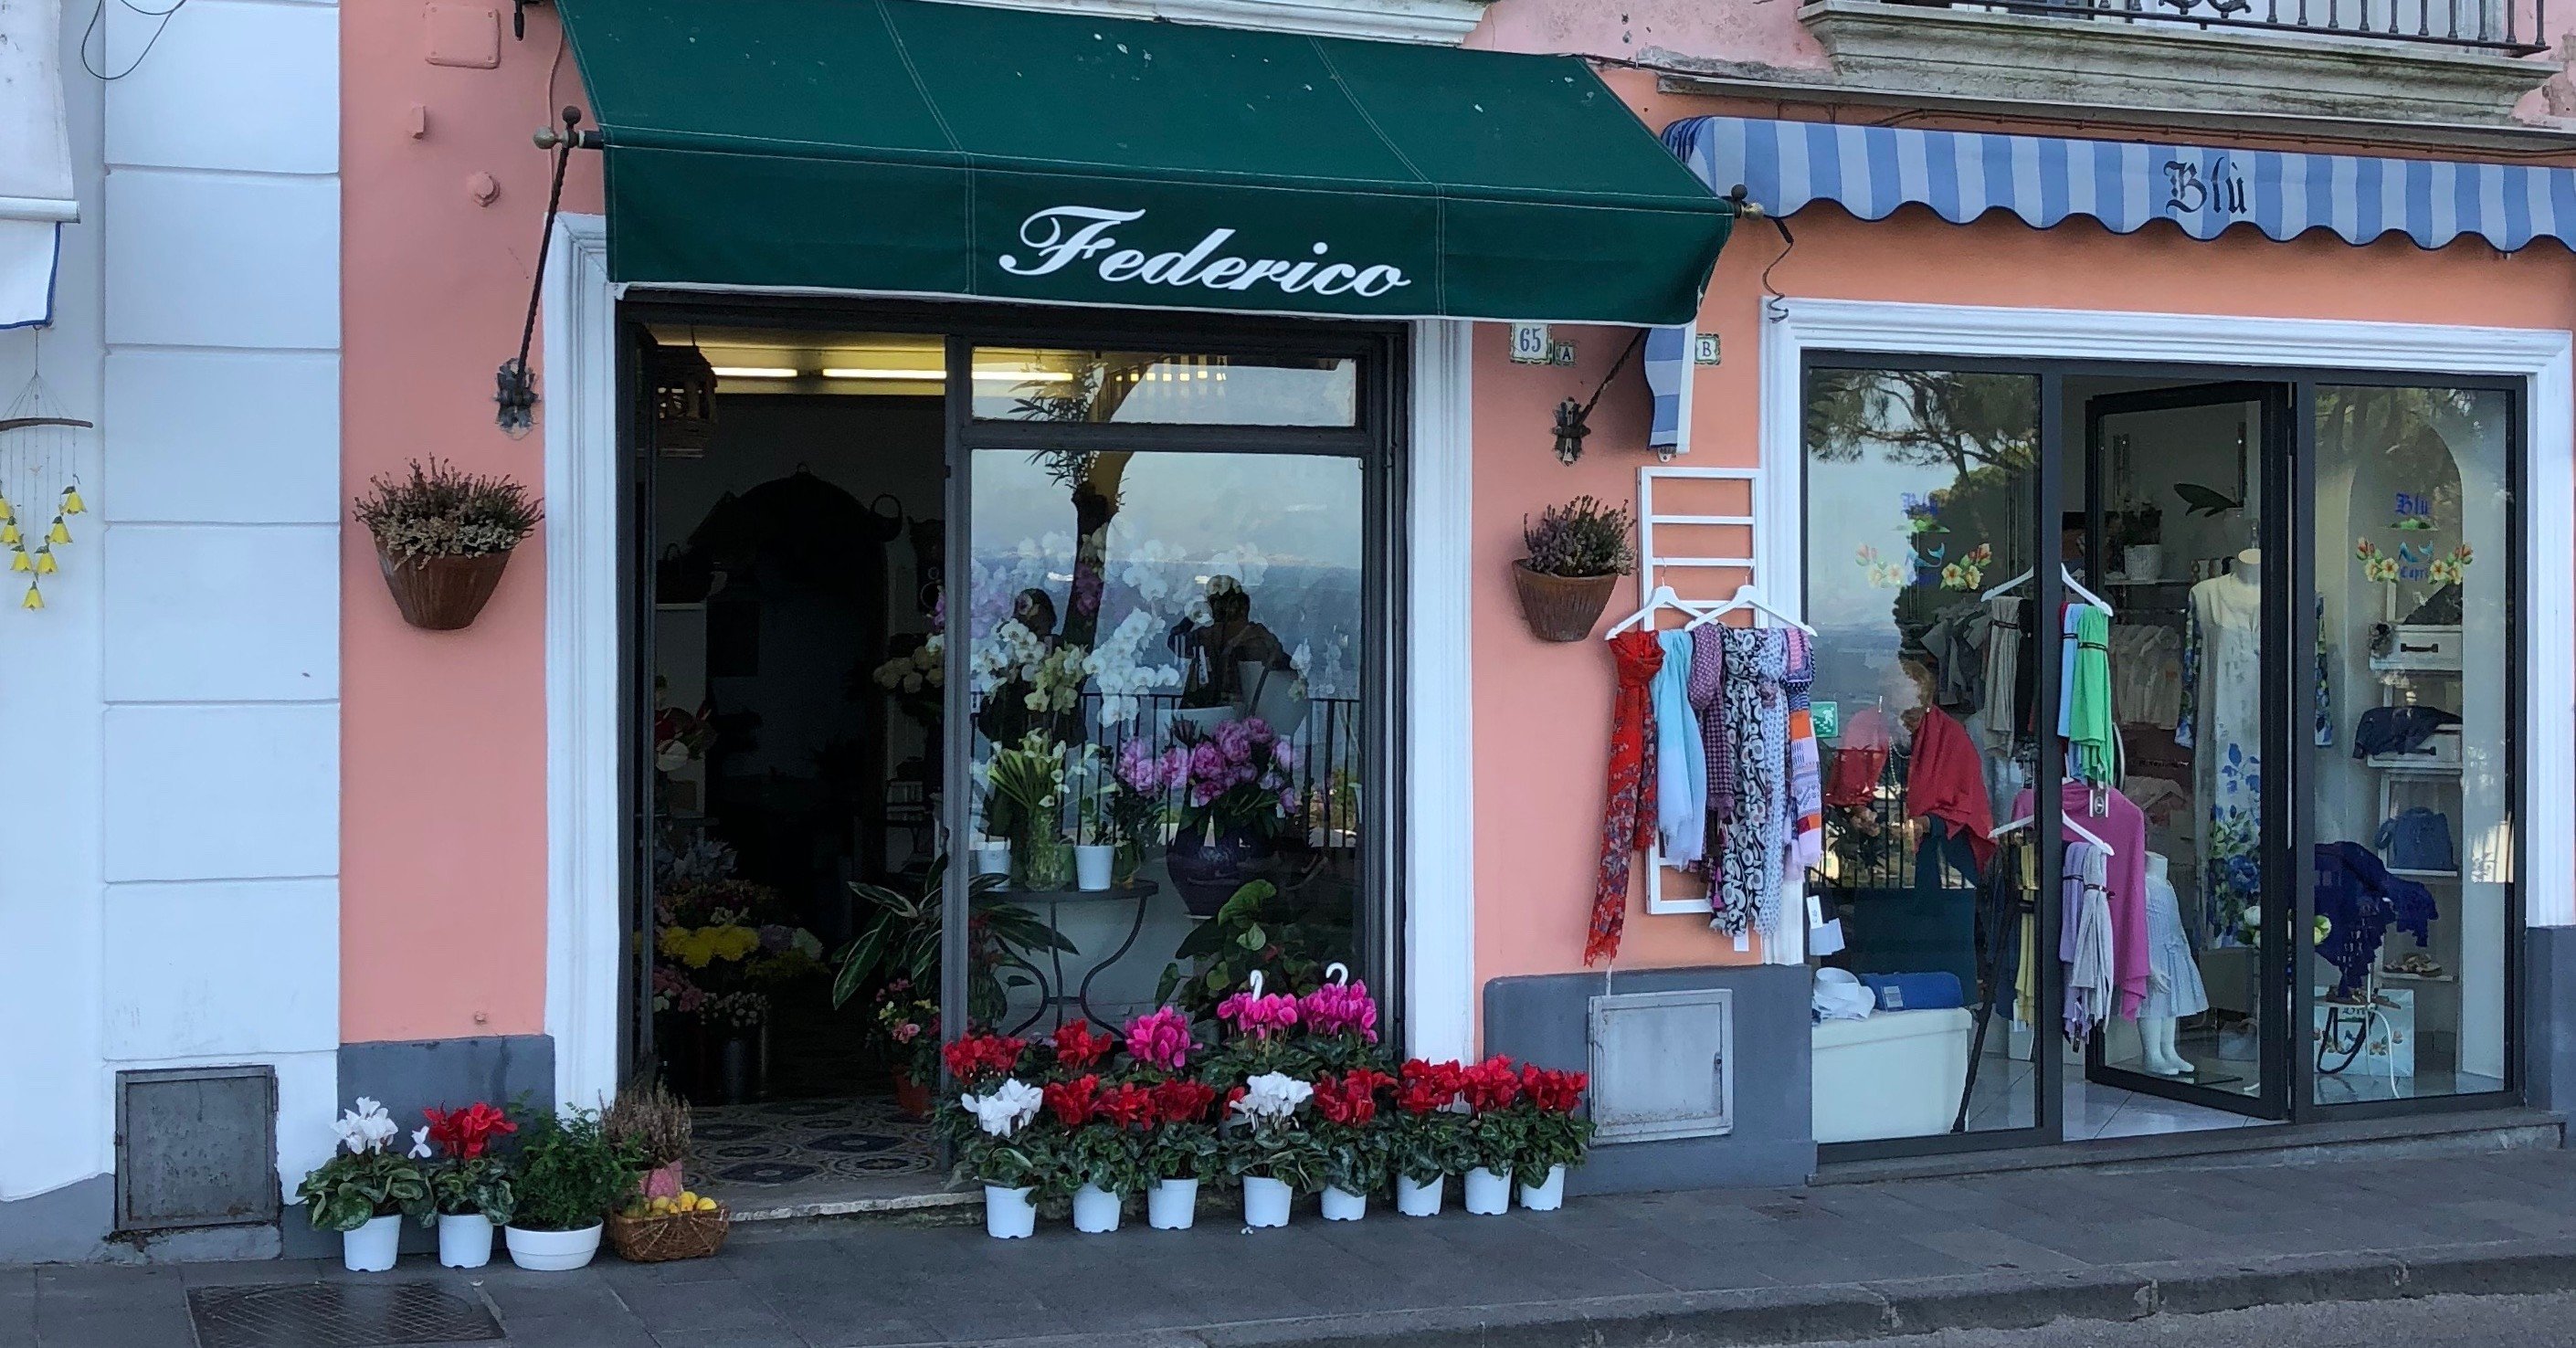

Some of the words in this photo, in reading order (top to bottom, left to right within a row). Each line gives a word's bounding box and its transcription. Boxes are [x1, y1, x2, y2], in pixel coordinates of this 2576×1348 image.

[998, 205, 1411, 297] Federico
[1519, 327, 1542, 353] 65
[1702, 341, 1712, 357] B
[1561, 346, 1571, 362] A
